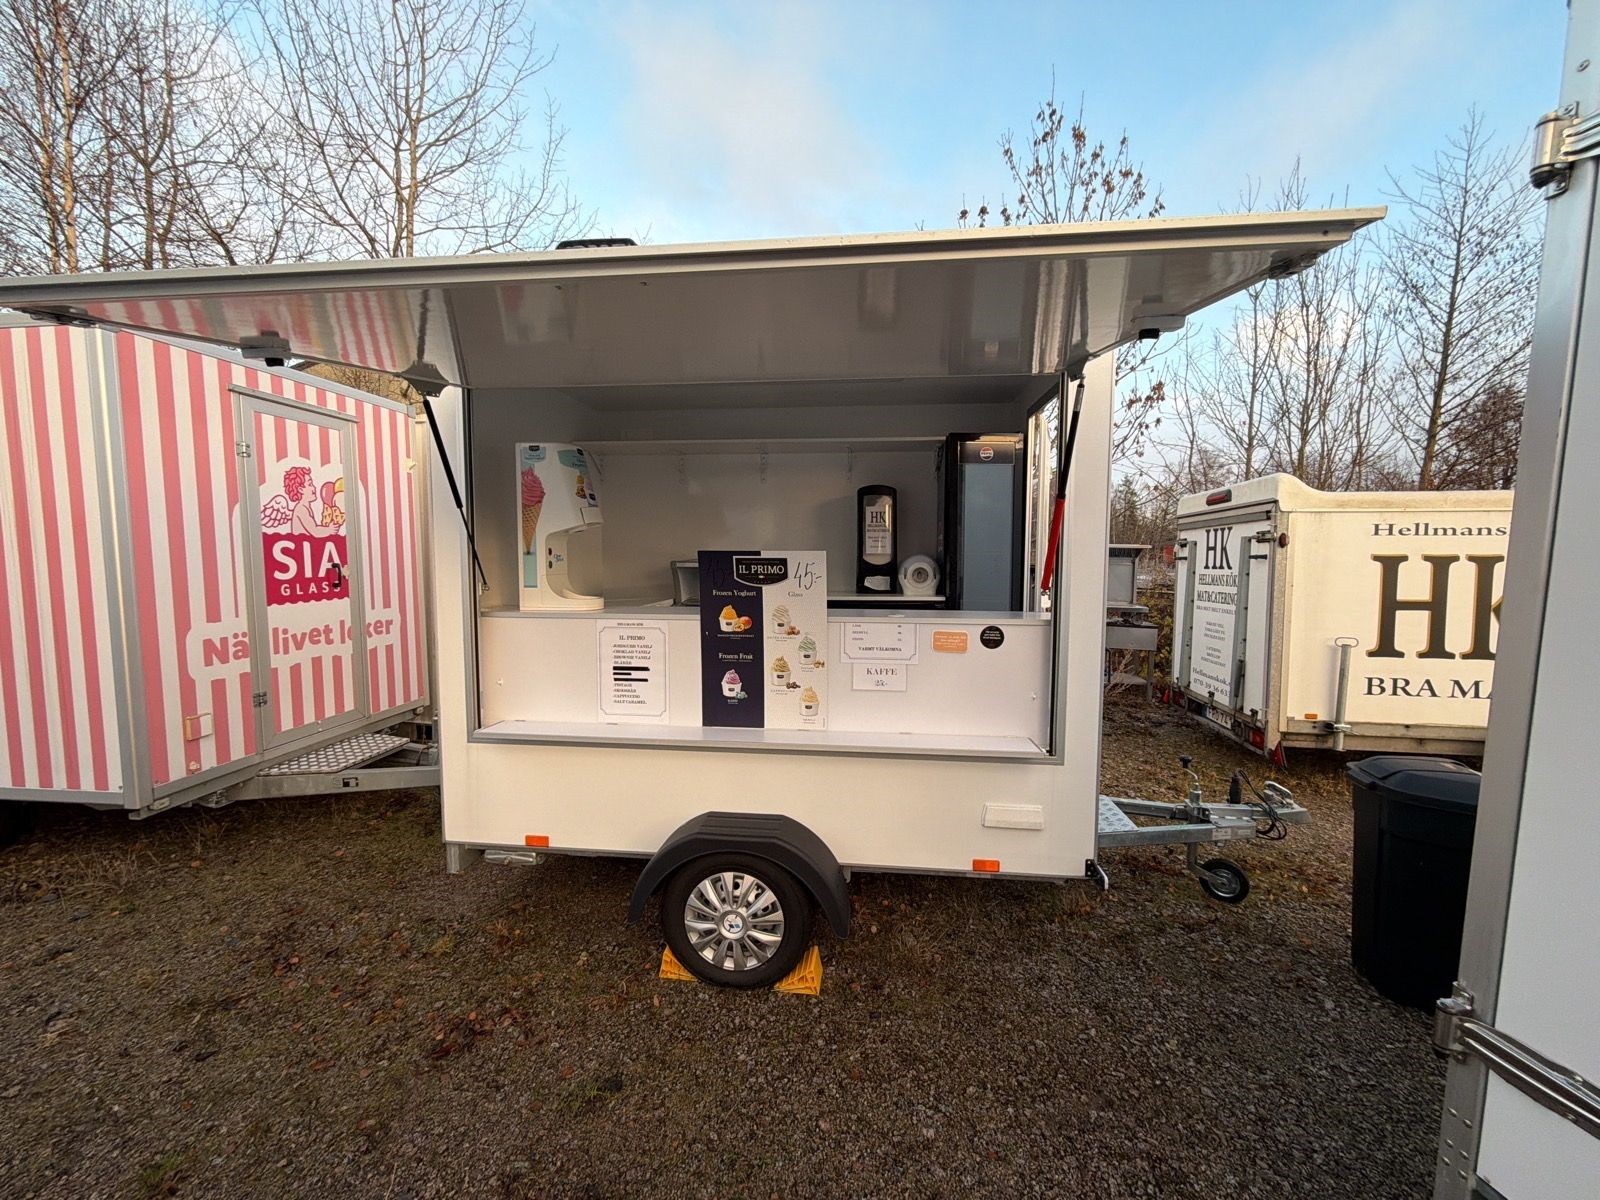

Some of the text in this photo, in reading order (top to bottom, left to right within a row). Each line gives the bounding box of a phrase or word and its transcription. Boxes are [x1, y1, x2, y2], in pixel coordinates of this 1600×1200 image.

[870, 511, 886, 523] HK
[1371, 522, 1507, 536] Hellmans
[1204, 526, 1233, 570] HK
[272, 540, 345, 580] SIA
[739, 565, 785, 574] IL PRIMO
[1198, 573, 1225, 586] HELLMANS
[734, 589, 757, 598] Yoghurt
[272, 624, 335, 656] livet
[739, 652, 753, 660] Fruit
[866, 667, 897, 675] KAFFE
[1363, 676, 1441, 698] BRA
